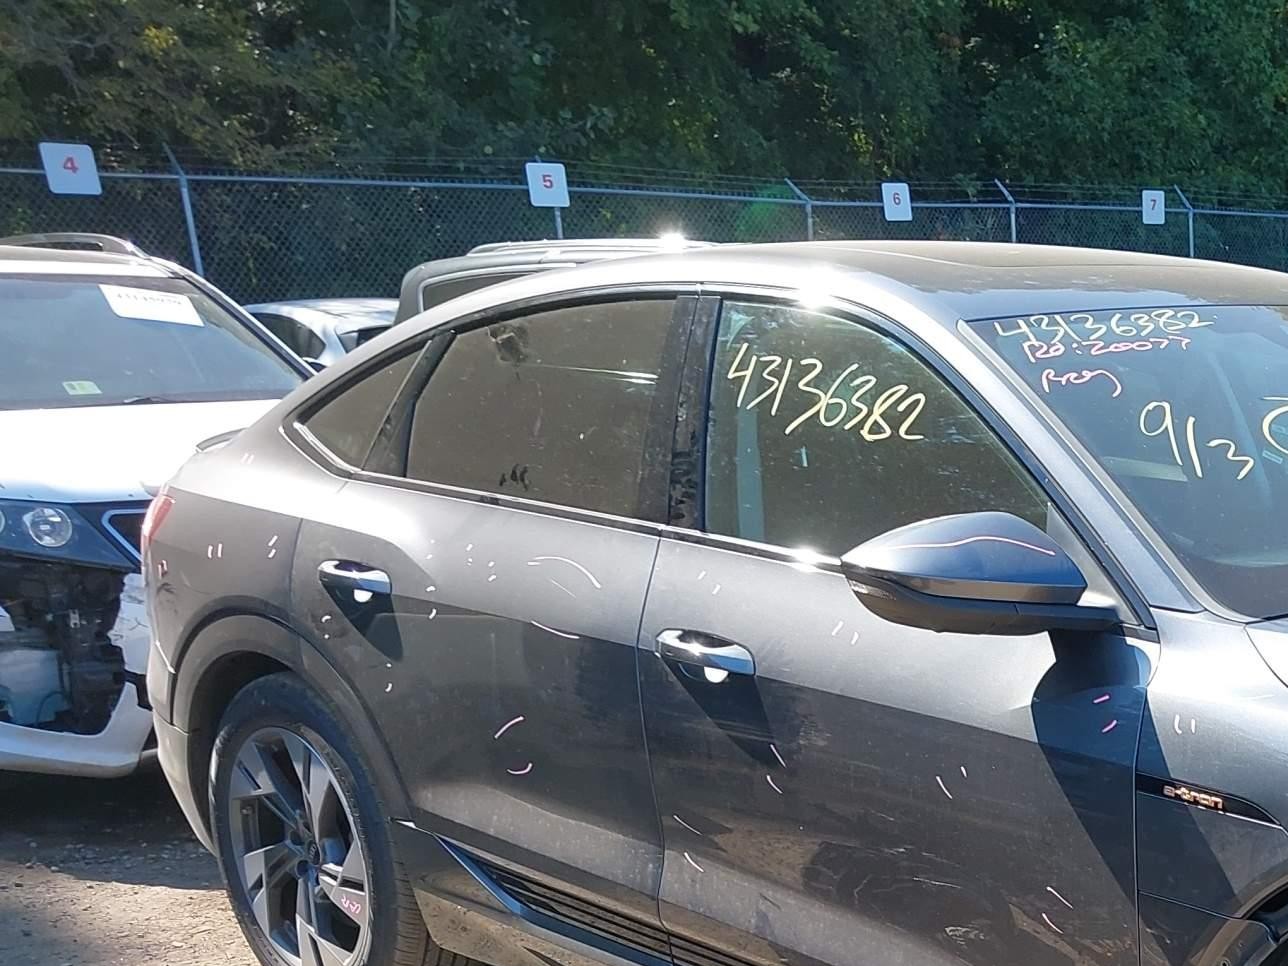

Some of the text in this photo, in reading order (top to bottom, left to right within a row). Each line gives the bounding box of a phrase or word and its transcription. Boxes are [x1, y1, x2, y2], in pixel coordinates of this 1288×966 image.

[63, 155, 79, 174] 4
[541, 174, 554, 189] 5
[892, 192, 901, 205] 6
[1150, 199, 1158, 211] 7
[994, 309, 1214, 344] 43136382
[727, 342, 926, 442] 43136382
[1139, 400, 1254, 480] 9/3
[1163, 785, 1223, 809] e-tron
